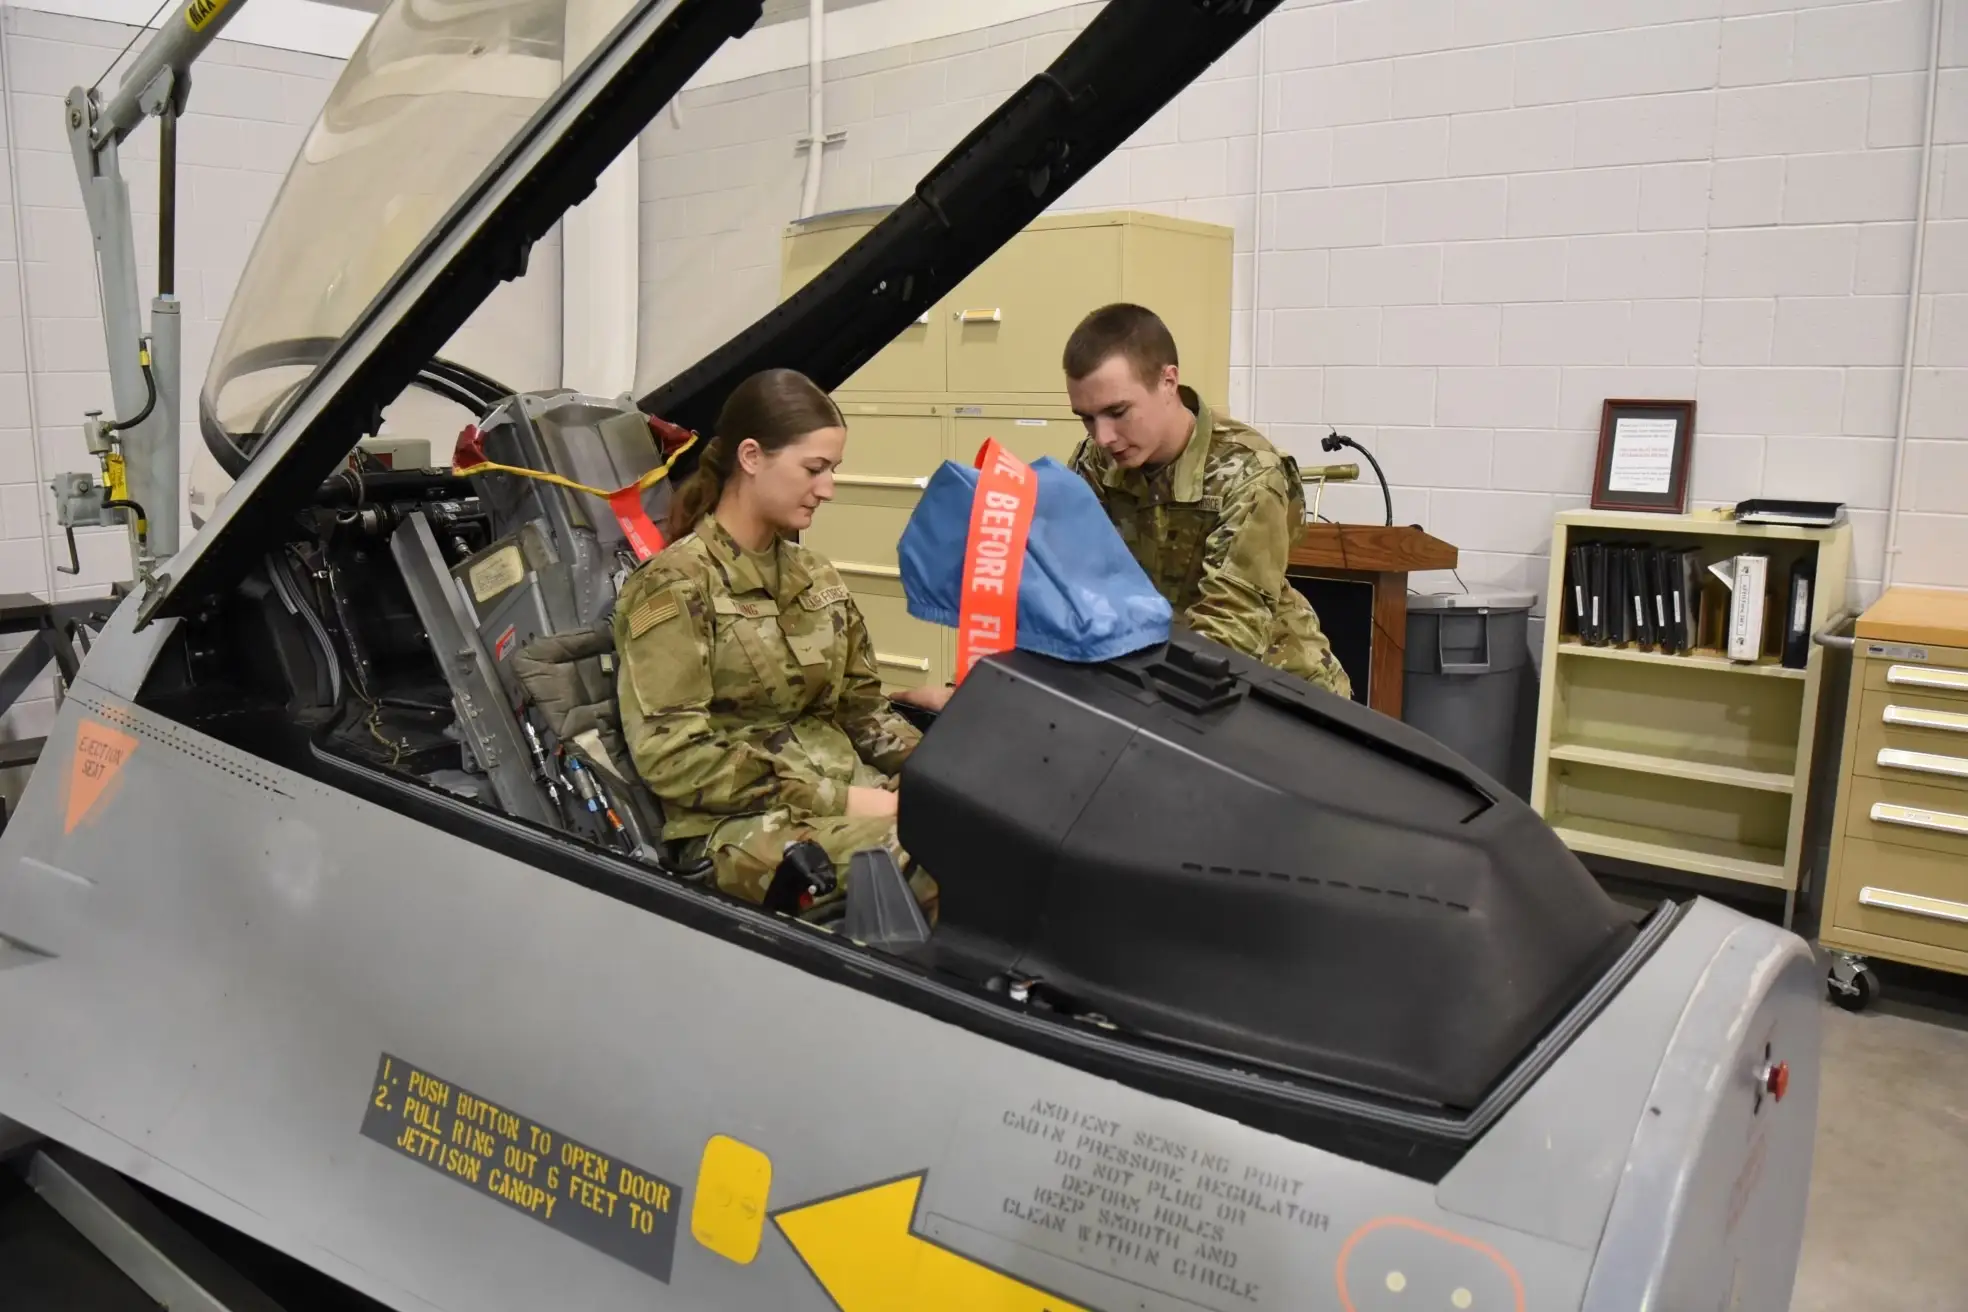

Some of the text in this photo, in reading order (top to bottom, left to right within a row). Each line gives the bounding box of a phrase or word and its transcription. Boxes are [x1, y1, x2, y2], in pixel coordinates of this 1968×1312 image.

[972, 490, 1020, 595] BEFORE
[375, 1085, 654, 1234] 2. PULL RING OUT 6 FEET TO
[383, 1058, 671, 1212] 1. PUSH BUTTON TO OPEN DOOR
[397, 1126, 557, 1219] JETTISON CANOPY
[1003, 1110, 1331, 1232] CABIN PRESSURE REGULATOR
[1133, 1131, 1229, 1174] SENSING
[1243, 1166, 1304, 1197] PORT
[1034, 1187, 1238, 1269] KEEP SMOOTH AND
[1054, 1150, 1247, 1226] DO NOT PLUG OR
[1061, 1174, 1225, 1243] DEFORM HOLES
[1003, 1198, 1260, 1303] CLEAN WITHIN CIRCLE
